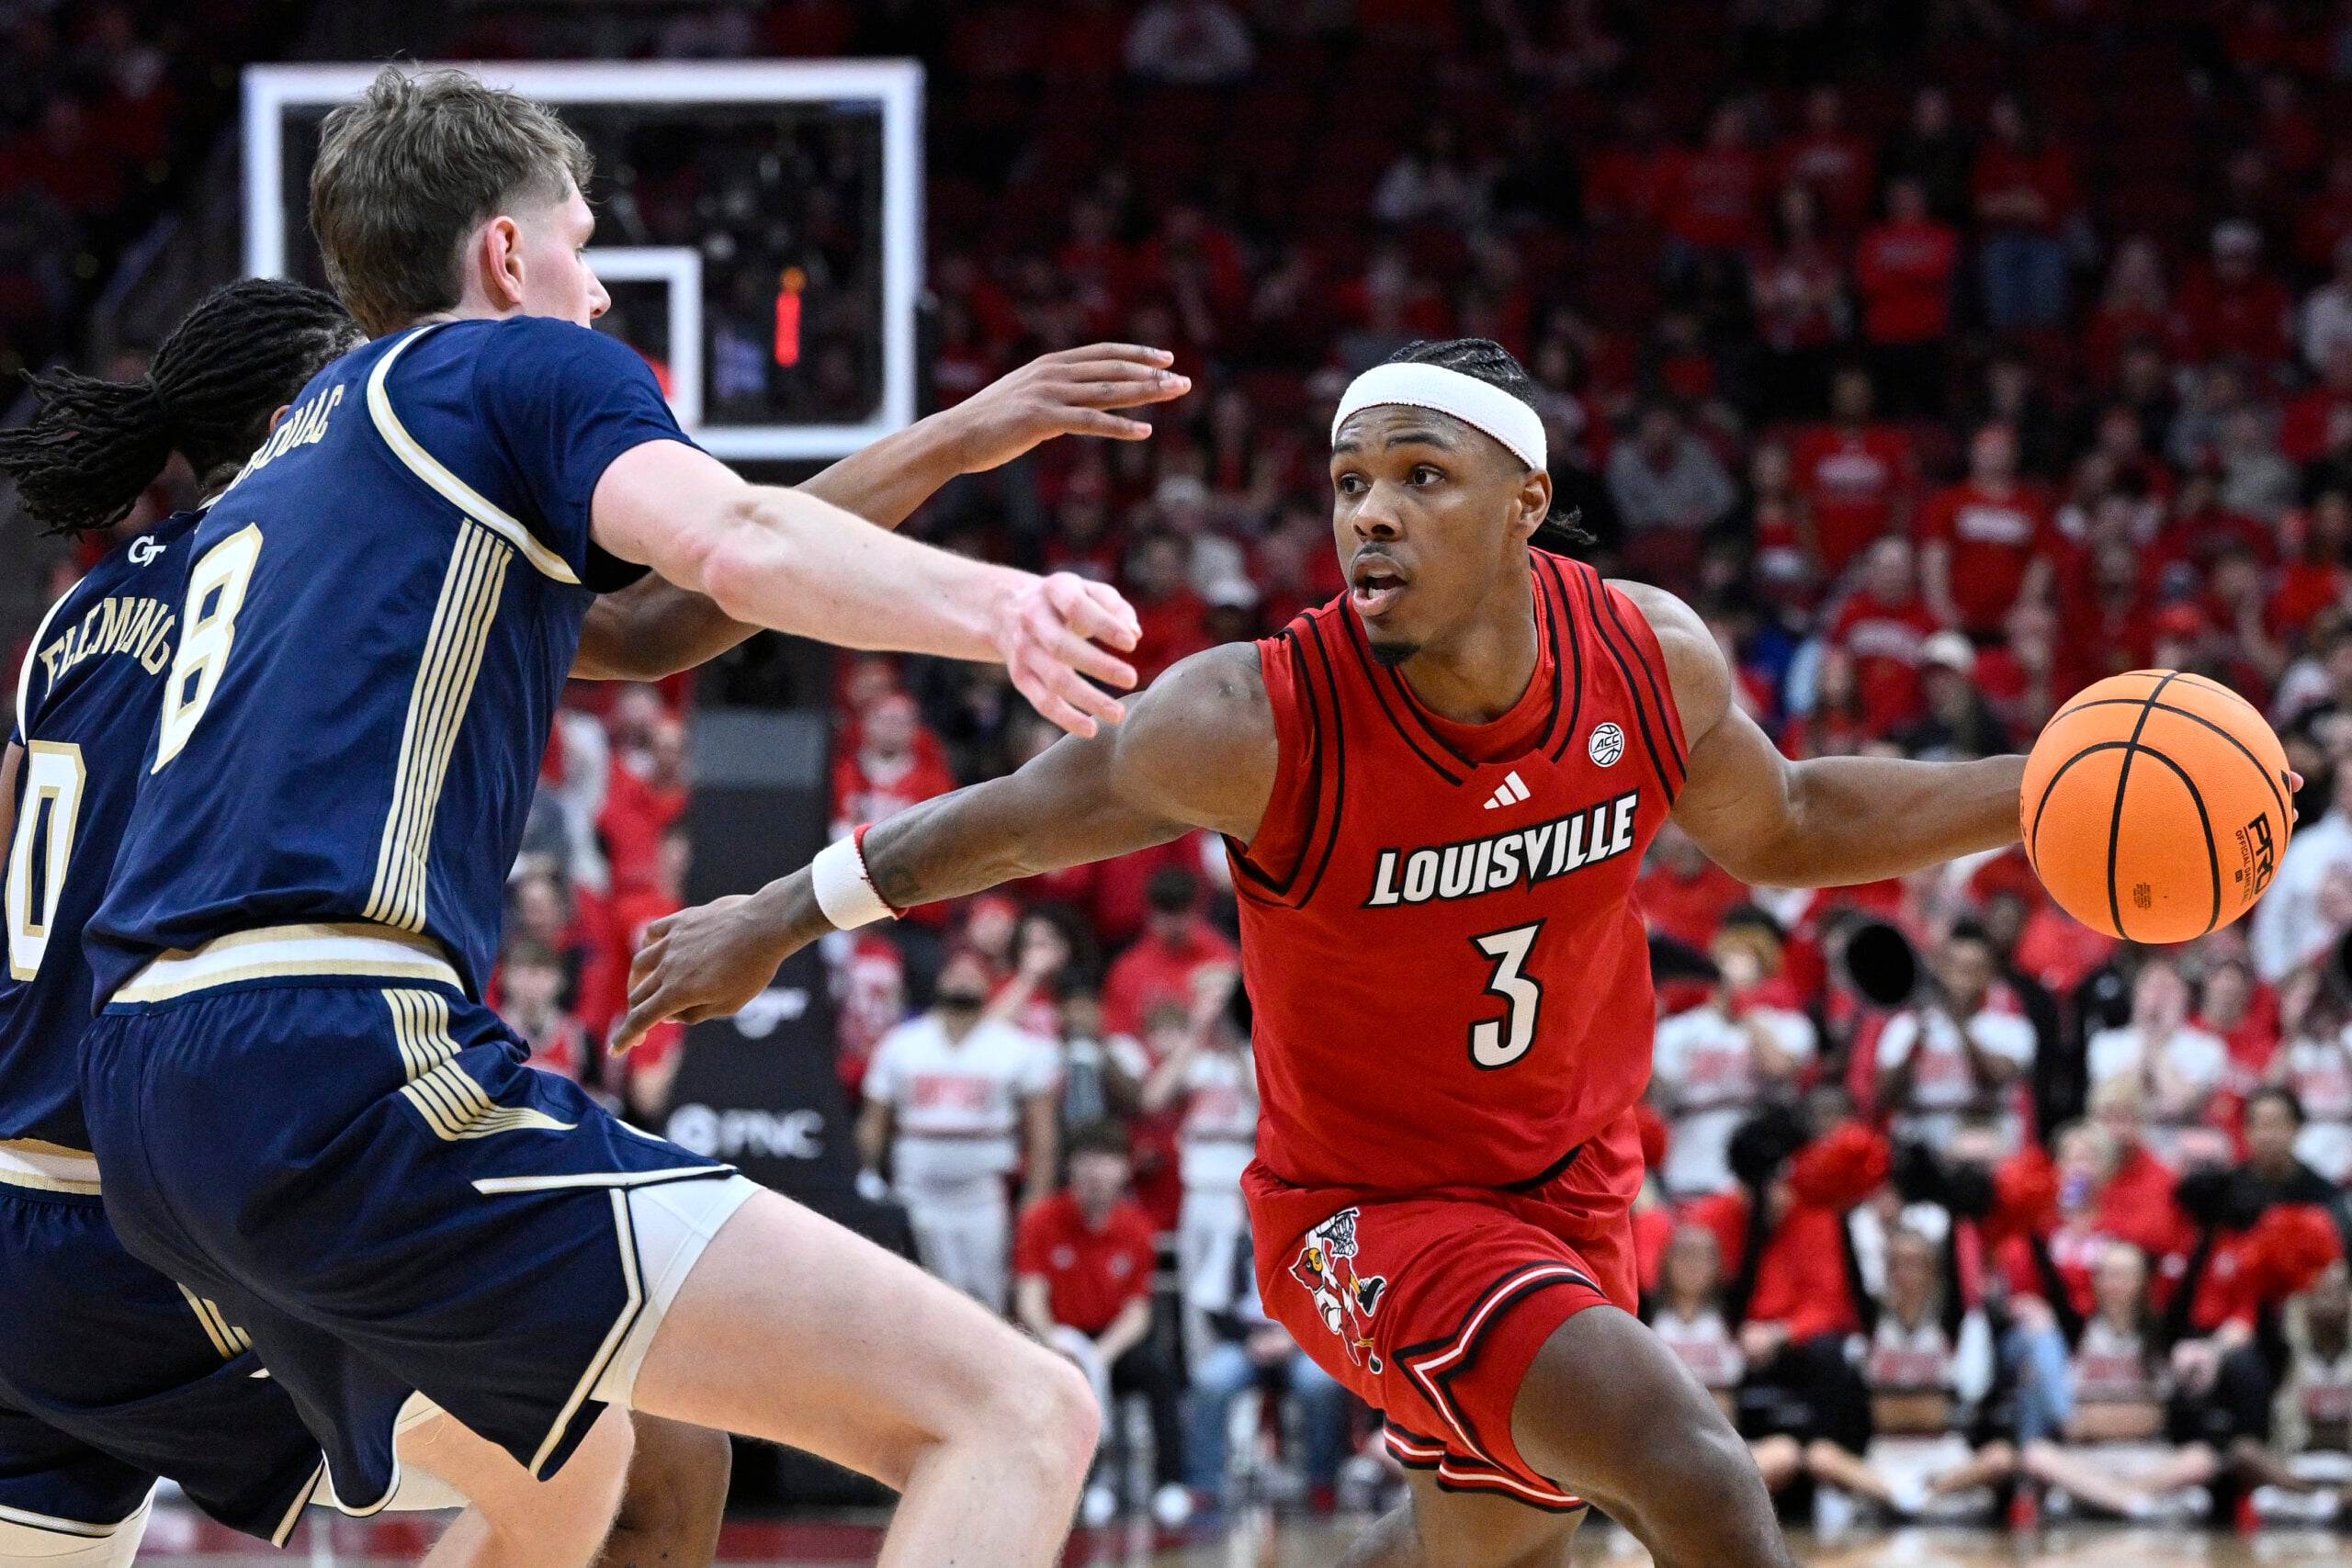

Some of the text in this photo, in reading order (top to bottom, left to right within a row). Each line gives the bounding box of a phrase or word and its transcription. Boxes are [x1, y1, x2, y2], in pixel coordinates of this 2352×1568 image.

[128, 535, 166, 567] GT
[39, 596, 175, 700] FLEMING
[150, 522, 264, 774] 8
[1594, 733, 1620, 750] ACC
[5, 739, 86, 981] 0
[1363, 792, 1638, 907] LOUISVILLE
[2235, 829, 2251, 867] OFFICIAL
[2248, 812, 2274, 894] PRO
[1470, 919, 1546, 1070] 3
